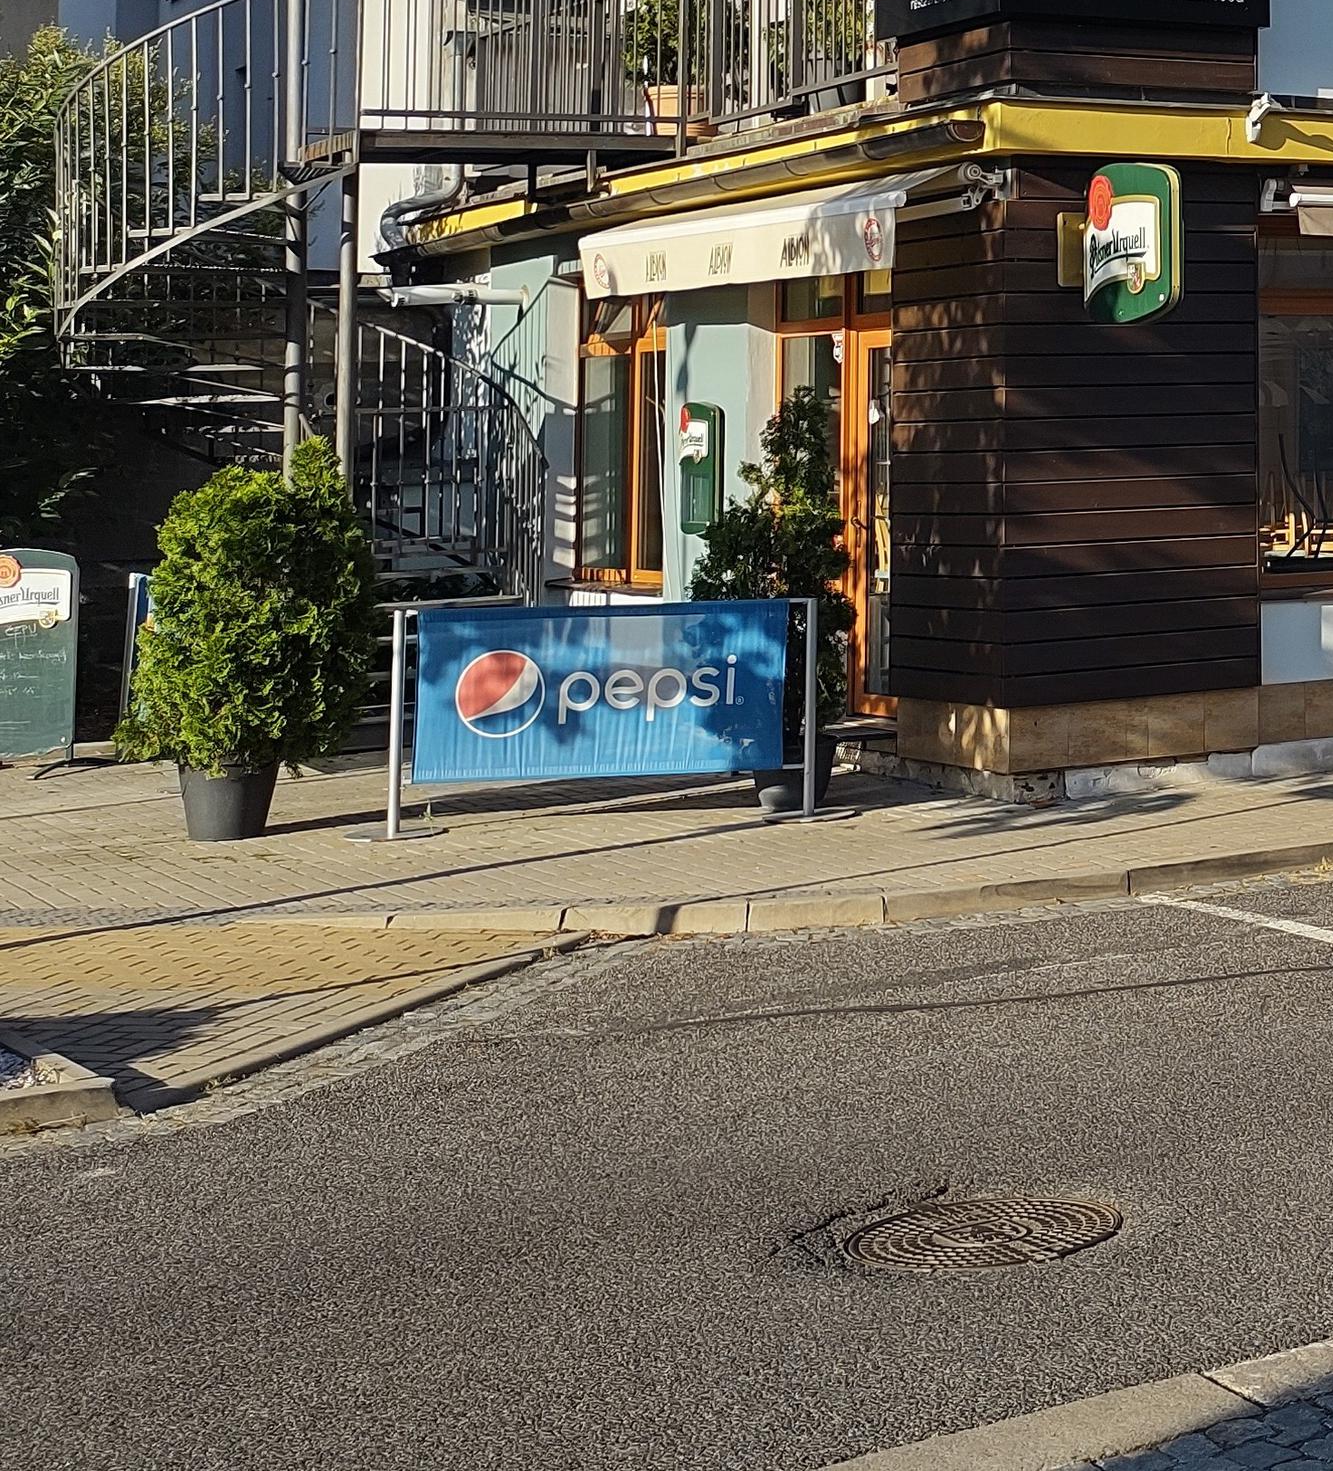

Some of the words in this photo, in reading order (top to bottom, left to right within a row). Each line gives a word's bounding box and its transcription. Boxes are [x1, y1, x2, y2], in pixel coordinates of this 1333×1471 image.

[779, 234, 810, 268] ALBION
[1112, 227, 1146, 262] Urquell
[20, 586, 59, 607] Urquell
[557, 654, 738, 725] pepsi
